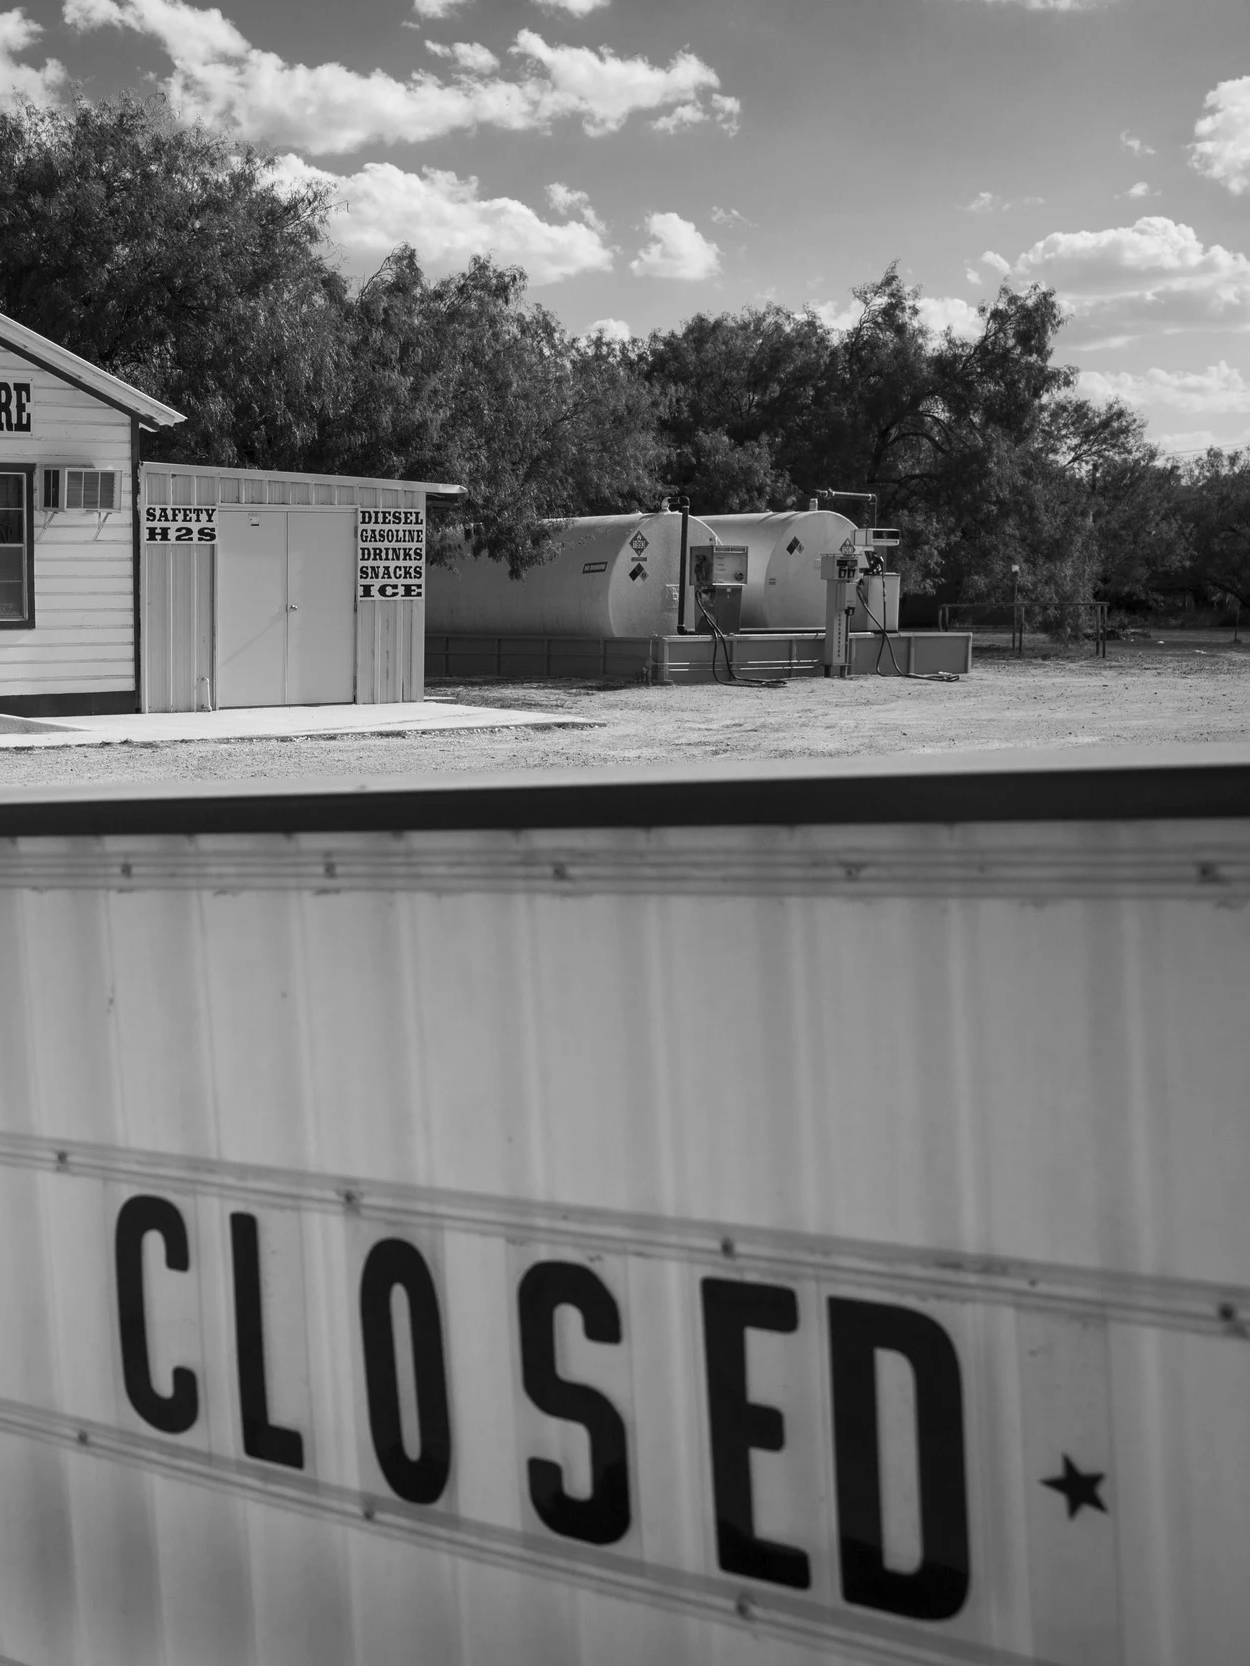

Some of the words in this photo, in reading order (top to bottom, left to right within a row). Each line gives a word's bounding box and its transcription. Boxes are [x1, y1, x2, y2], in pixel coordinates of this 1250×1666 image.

[146, 507, 216, 522] SAFETY
[360, 511, 423, 525] DIESEL
[146, 527, 217, 541] H2S
[360, 529, 423, 543] GASOLINE
[360, 548, 423, 561] DRINKS
[360, 566, 423, 579] SNACKS
[359, 584, 423, 598] ICE
[116, 1195, 971, 1620] CLOSED
